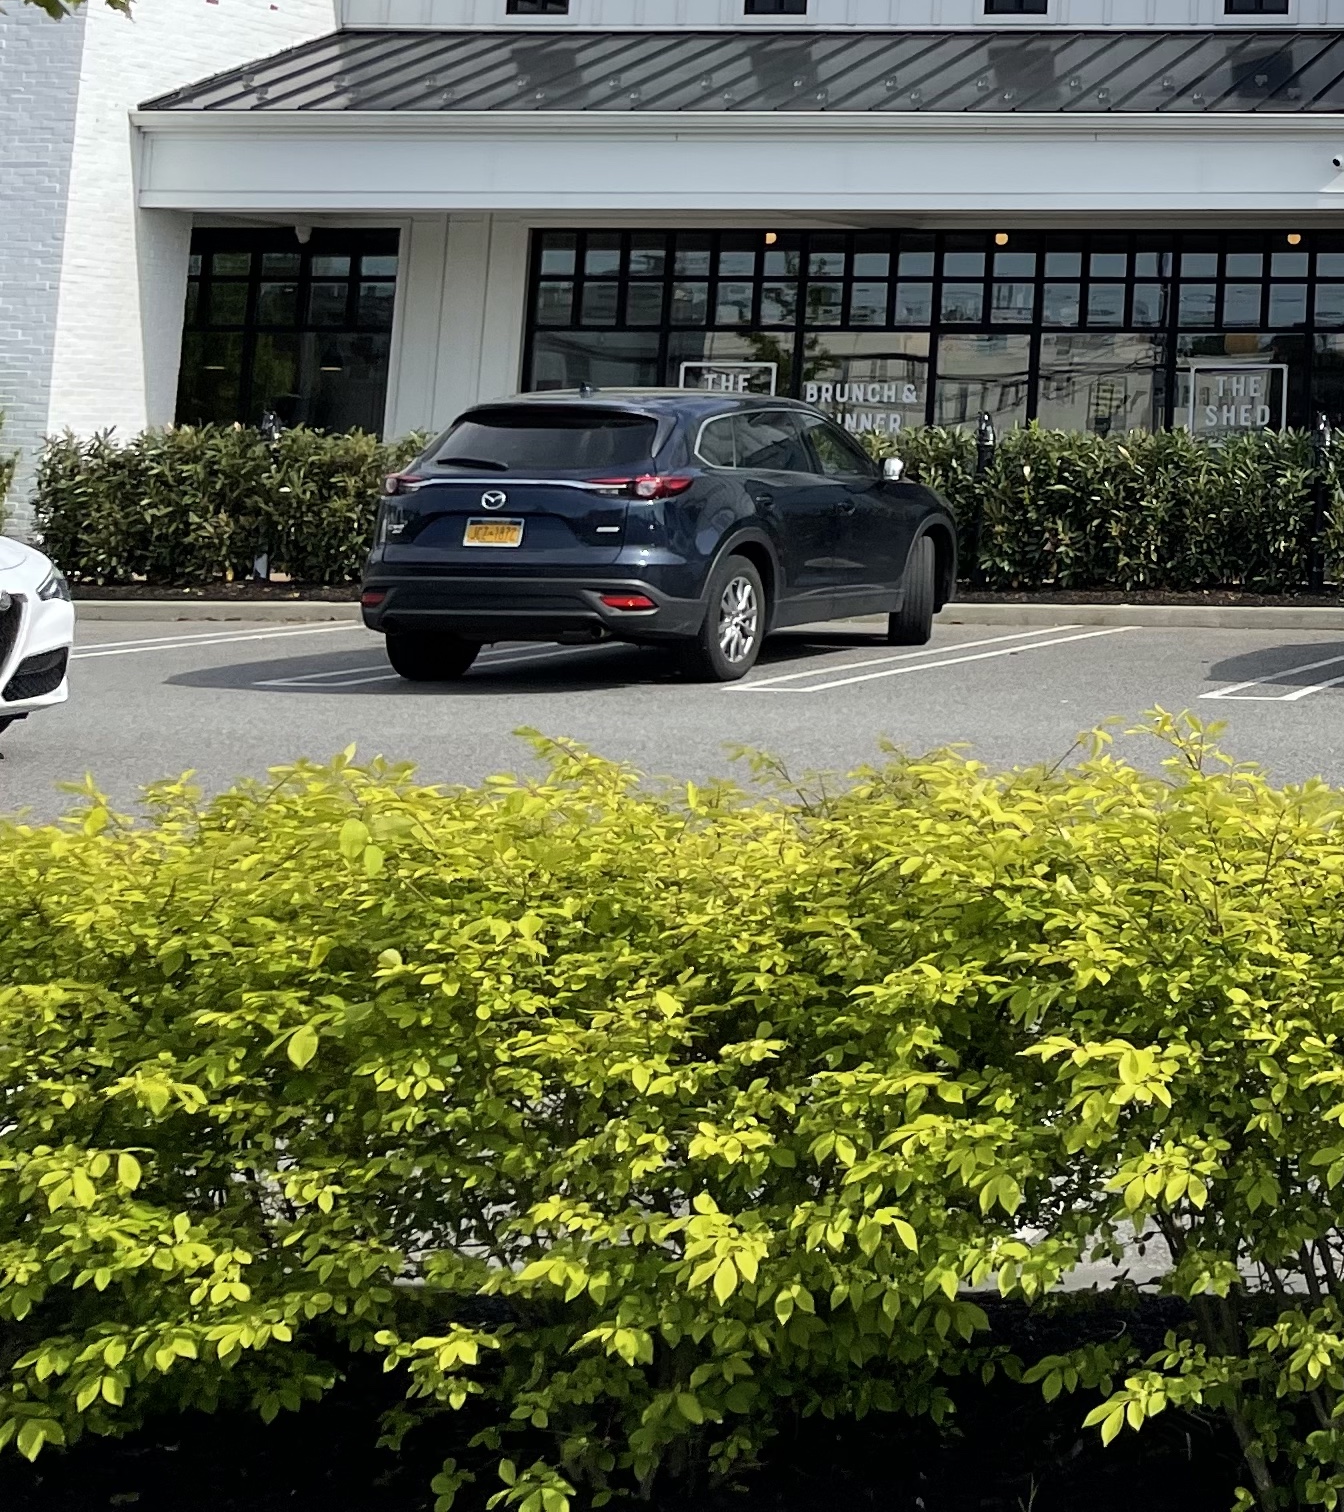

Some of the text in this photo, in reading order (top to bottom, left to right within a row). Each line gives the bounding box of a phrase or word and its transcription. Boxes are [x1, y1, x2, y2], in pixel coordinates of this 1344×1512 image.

[704, 374, 751, 392] THE
[806, 383, 917, 403] BRUNCH &
[1216, 376, 1263, 397] THE
[1205, 404, 1271, 427] SHED
